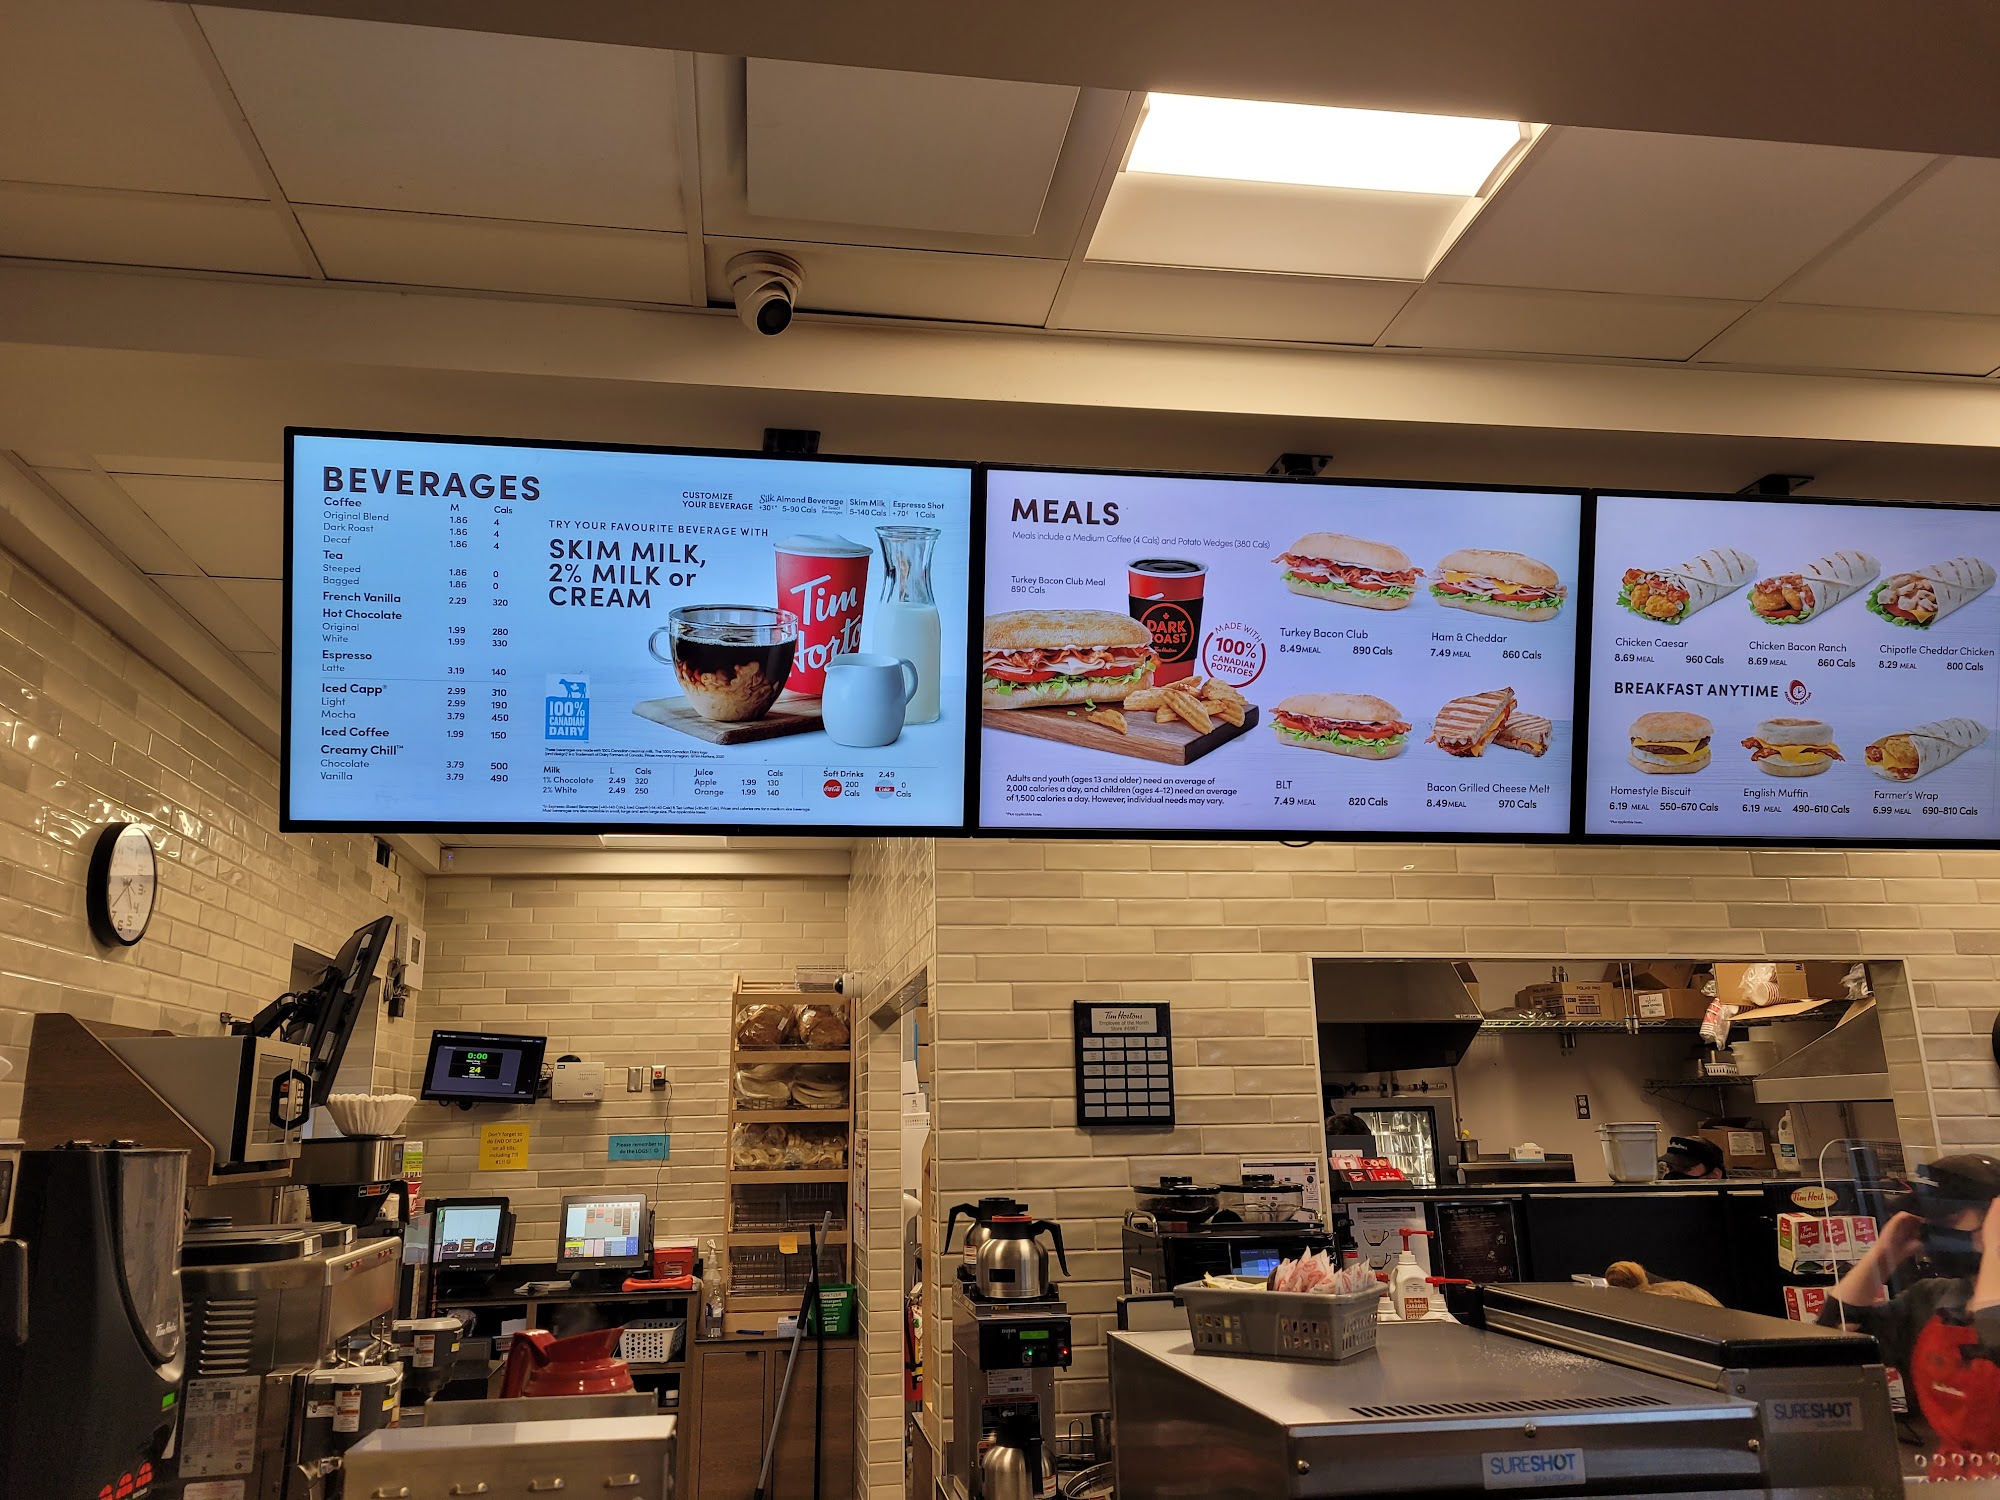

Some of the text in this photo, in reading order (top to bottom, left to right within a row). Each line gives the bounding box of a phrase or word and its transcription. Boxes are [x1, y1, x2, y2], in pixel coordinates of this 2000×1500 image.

[324, 466, 539, 500] BEVERAGES
[683, 492, 732, 500] CUSTOMIZE
[324, 497, 361, 507] Coffee
[494, 506, 512, 514] Cals
[709, 502, 752, 510] BEVERAGE
[808, 497, 843, 507] Beverage
[893, 501, 926, 509] Espresso
[324, 511, 360, 521] Original
[364, 513, 388, 521] Blend
[1012, 498, 1119, 525] MEALS
[549, 520, 767, 536] TRY YOUR FAVOURITE BEVERAGE WITH
[1038, 532, 1064, 540] include
[1073, 534, 1104, 542] Medium
[1107, 535, 1131, 543] Coffee
[1134, 536, 1140, 544] (4
[1142, 536, 1159, 545] Cals)
[1178, 538, 1201, 546] Potato
[1203, 539, 1233, 548] Wedges
[1235, 540, 1250, 548] (380
[1252, 540, 1270, 549] Cals)
[323, 550, 342, 559] Tea
[550, 539, 705, 568] SKIM MILK,
[549, 564, 696, 586] 2% MILK or
[1011, 576, 1037, 585] Turkey
[1086, 578, 1105, 586] Meal
[324, 592, 360, 601] French
[364, 593, 400, 602] Vanilla
[549, 586, 650, 608] CREAM
[790, 574, 858, 626] Tim
[323, 608, 402, 619] Hot Chocolate
[322, 623, 359, 632] Original
[1146, 620, 1186, 633] DARK
[1215, 622, 1262, 643] MADE WITH
[1280, 628, 1368, 639] Turkey Bacon Club
[1432, 632, 1507, 642] Ham & Cheddar
[1152, 633, 1187, 644] OAST
[1616, 638, 1688, 647] Chicken Caesar
[1216, 637, 1256, 658] 100%
[1280, 644, 1301, 652] 8.49
[1353, 646, 1370, 654] 890
[1373, 646, 1392, 655] Cals
[1880, 645, 1994, 656] Chipotle Cheddar Chicken
[323, 650, 372, 662] Espresso
[1212, 654, 1256, 669] CANADIAN
[1211, 662, 1254, 677] POTATOES
[322, 683, 346, 692] Iced
[1615, 682, 1778, 697] BREAKFAST ANYTIME
[549, 701, 585, 716] 100%
[549, 716, 585, 726] CANADIAN
[322, 727, 346, 736] Iced
[350, 728, 389, 736] Coffee
[549, 726, 585, 736] DAIRY
[321, 745, 368, 757] Creamy
[320, 772, 352, 780] Vanilla
[694, 769, 713, 777] Juice
[694, 779, 717, 787] Apple
[1276, 780, 1292, 789] BLT
[1428, 783, 1550, 793] Bacon Grilled Cheese Melt
[1744, 788, 1808, 799] English Muffin
[1875, 791, 1938, 802] Farmer's Wrap
[1105, 1011, 1142, 1019] Tim Hortons
[1792, 1192, 1806, 1201] Tim
[1800, 1231, 1818, 1239] Hortons
[1774, 1403, 1853, 1420] SURESHOT
[1490, 1454, 1576, 1475] SURESHOT
